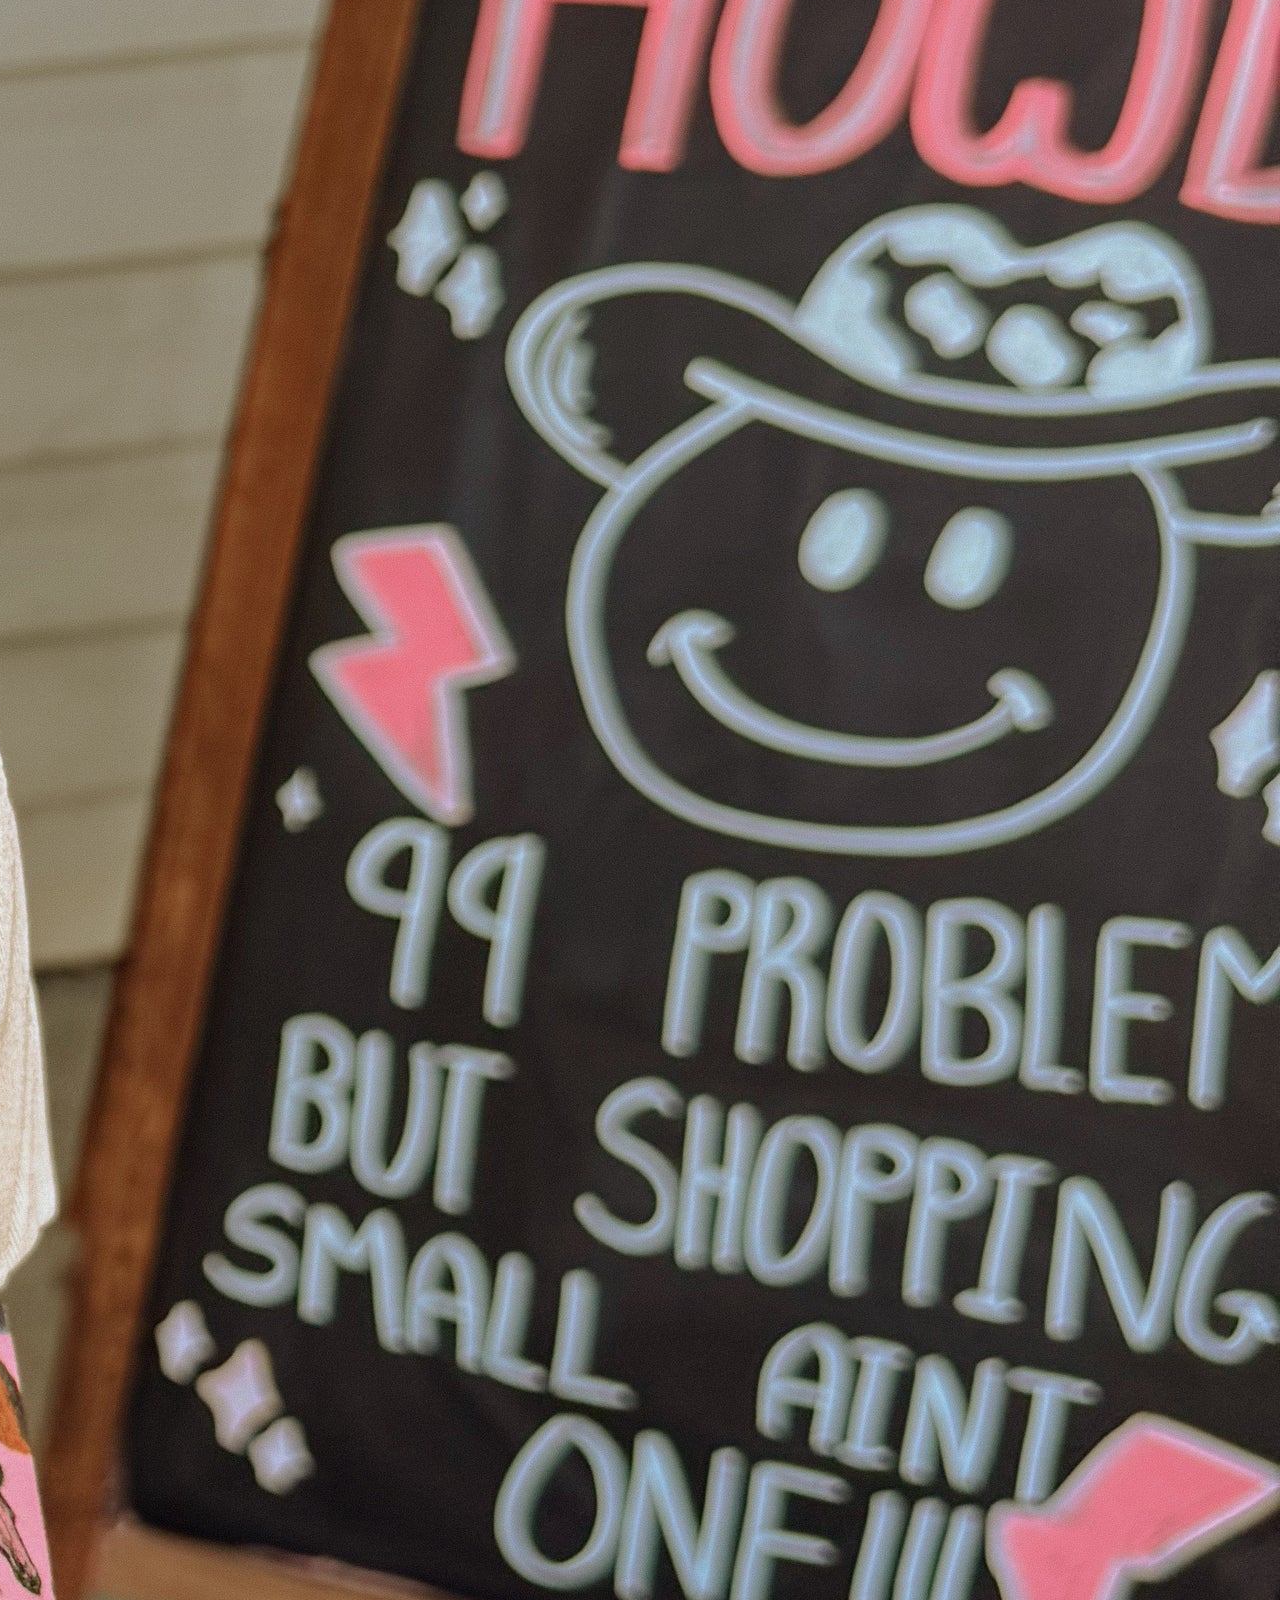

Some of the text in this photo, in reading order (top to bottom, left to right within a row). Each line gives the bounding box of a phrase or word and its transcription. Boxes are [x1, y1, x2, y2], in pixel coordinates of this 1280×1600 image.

[345, 816, 547, 1028] 99
[201, 1182, 1104, 1503] SMALL AINT
[268, 1012, 1280, 1365] BUT SHOPPING
